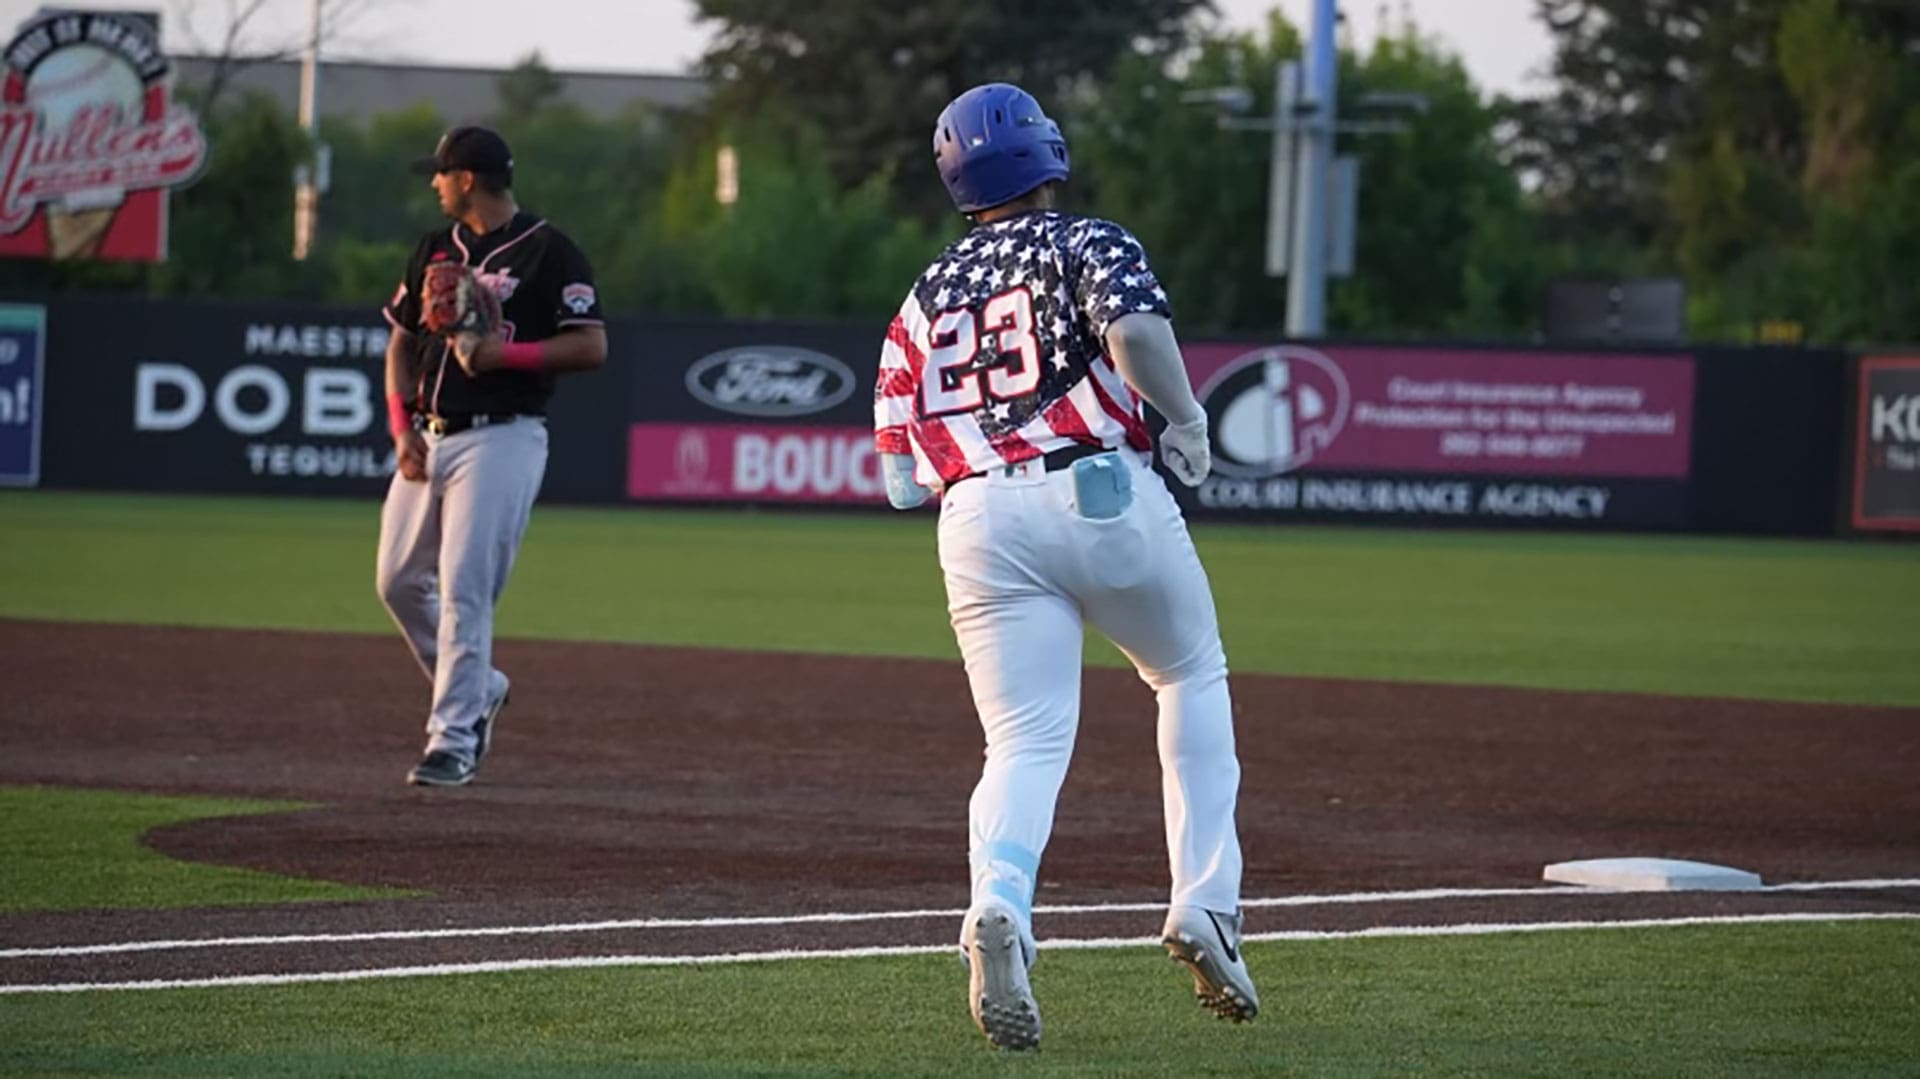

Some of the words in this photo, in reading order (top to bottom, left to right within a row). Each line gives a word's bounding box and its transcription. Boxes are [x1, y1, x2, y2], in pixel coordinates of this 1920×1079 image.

[245, 323, 388, 357] MAESTR
[920, 285, 1040, 417] 23
[135, 363, 374, 434] DOB
[713, 353, 828, 405] Ford
[1354, 400, 1464, 427] Protection
[1504, 406, 1540, 429] the
[1301, 479, 1473, 514] INSURANCE
[1479, 482, 1610, 518] AGENCY
